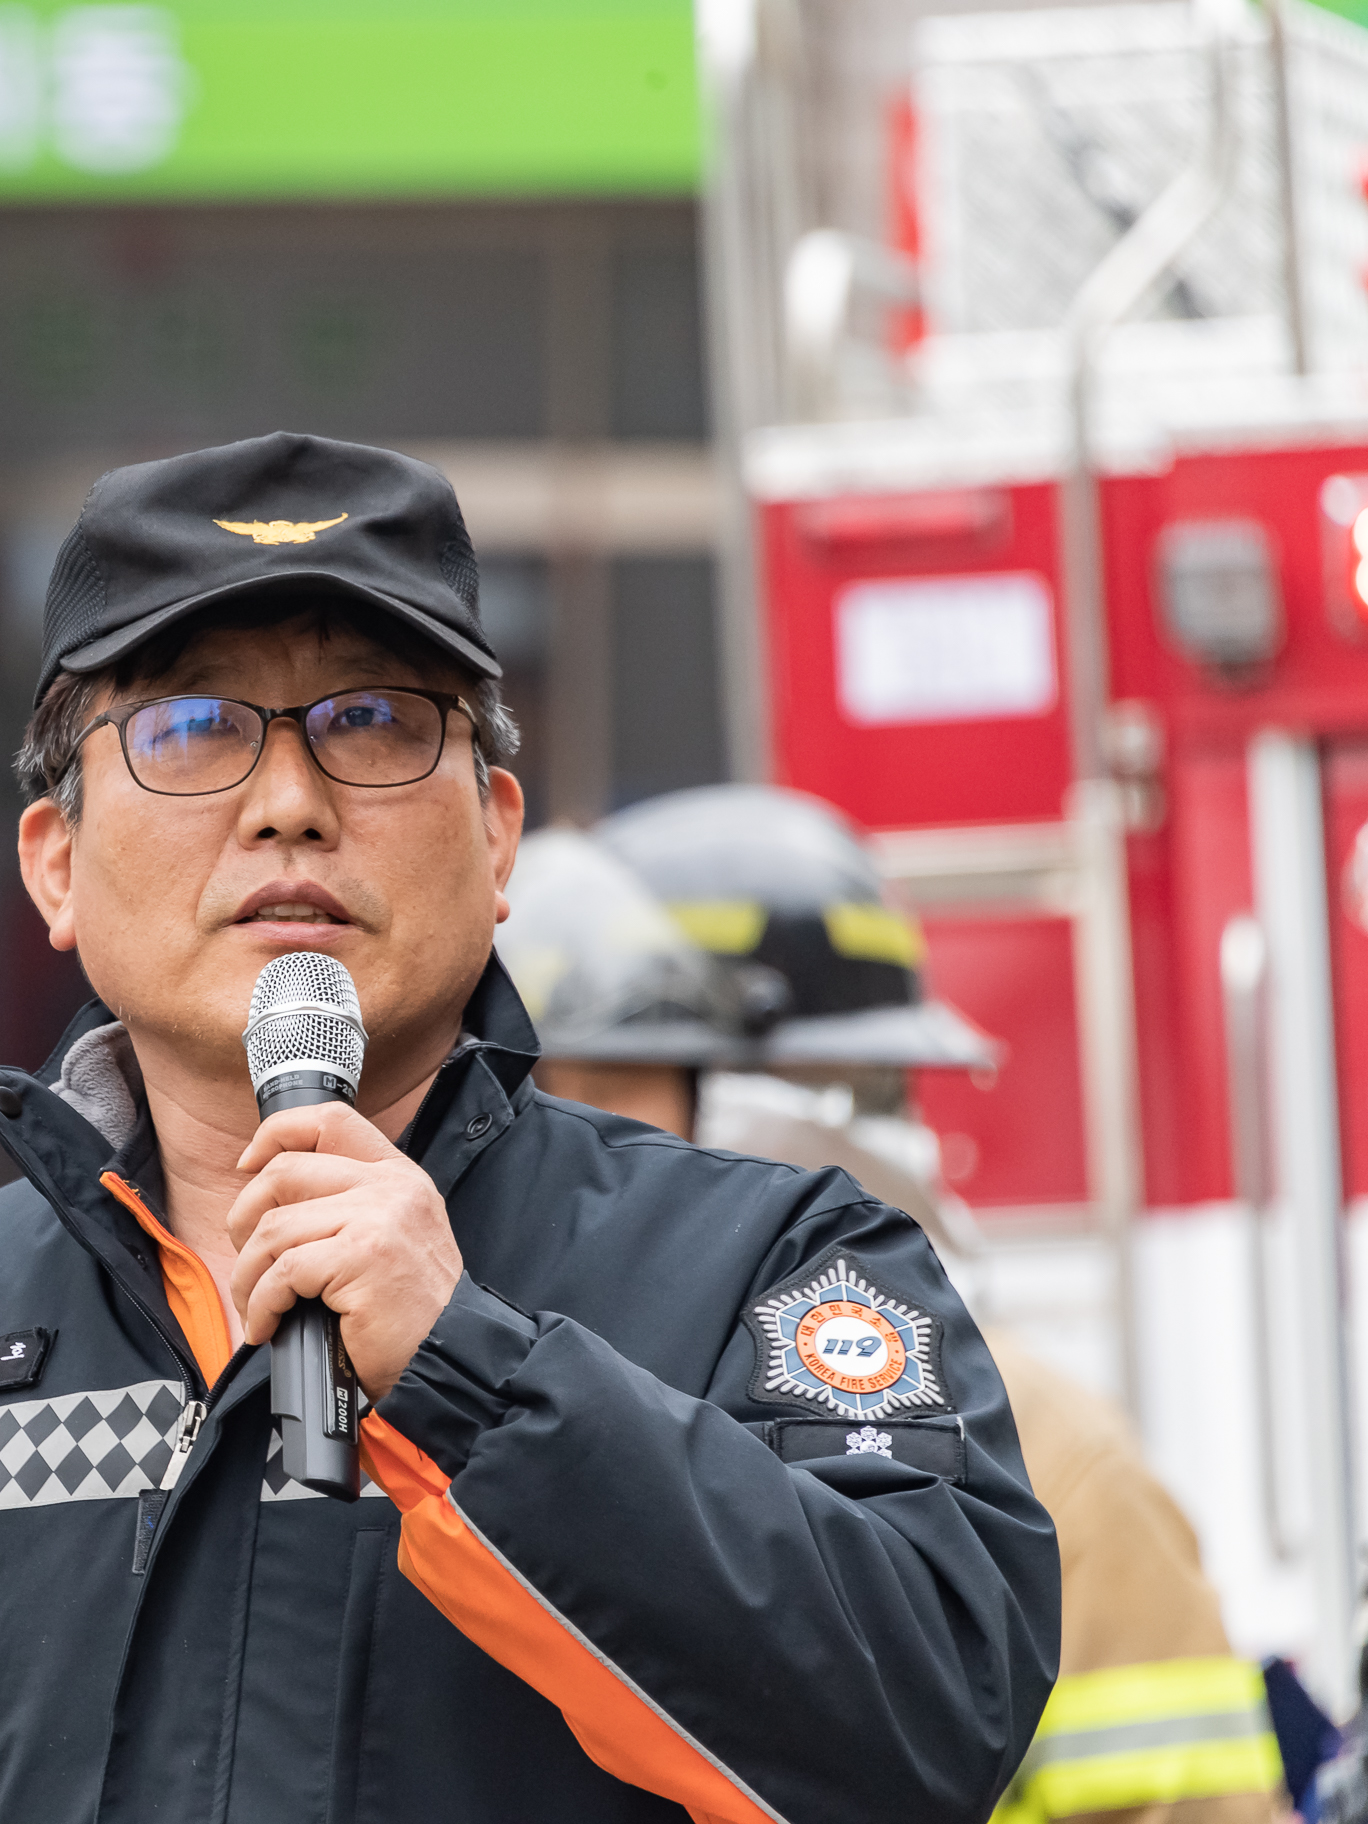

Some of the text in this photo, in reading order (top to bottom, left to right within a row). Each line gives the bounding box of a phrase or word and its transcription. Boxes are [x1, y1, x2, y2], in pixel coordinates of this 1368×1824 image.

[822, 1335, 882, 1358] 119
[804, 1352, 903, 1390] KOREA FIRE SERVICE
